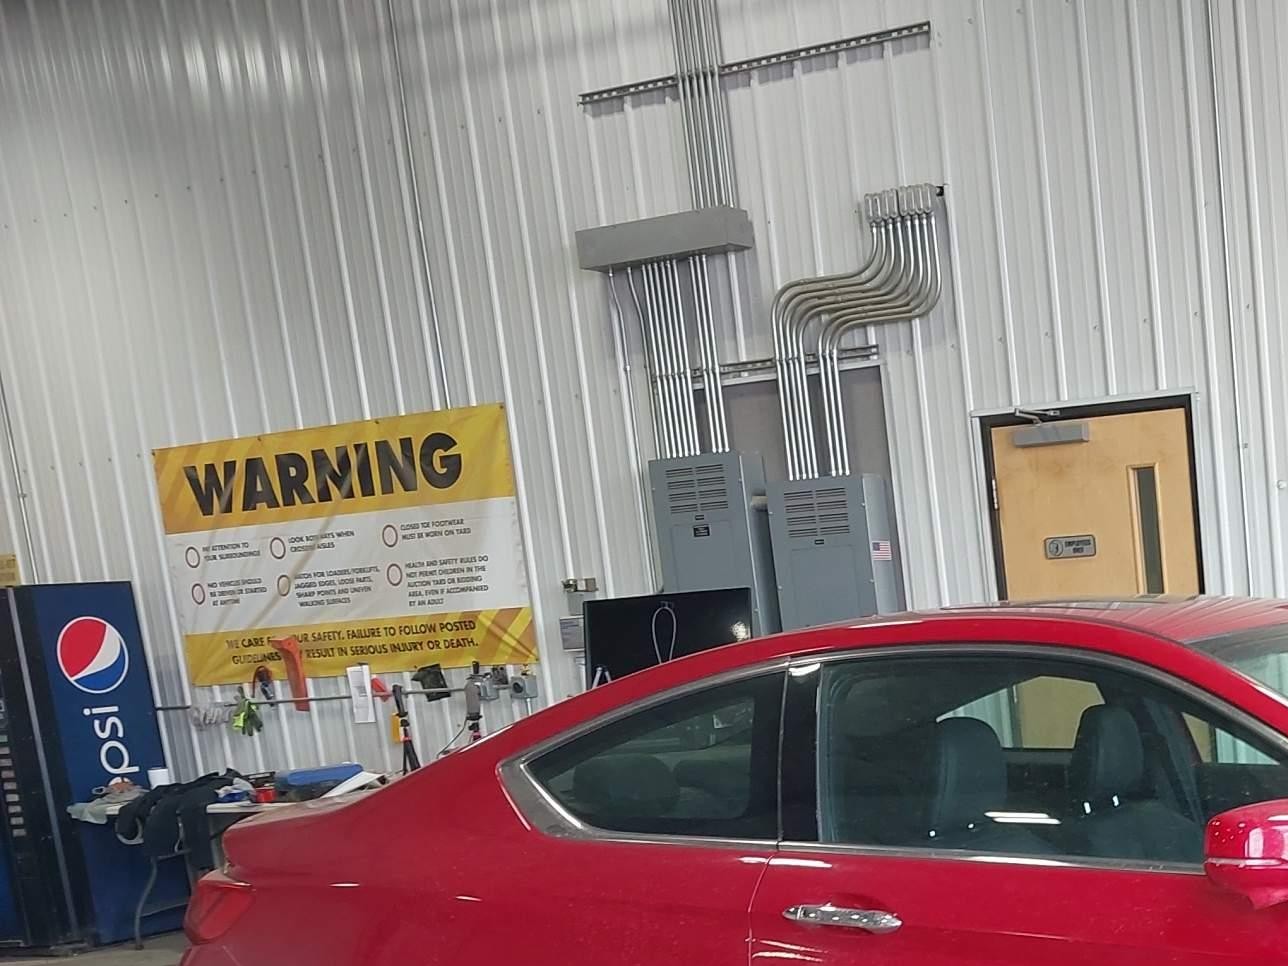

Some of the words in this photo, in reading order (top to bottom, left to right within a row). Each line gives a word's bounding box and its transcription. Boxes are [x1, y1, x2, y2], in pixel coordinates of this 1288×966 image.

[184, 432, 463, 517] WARNING
[431, 519, 464, 528] FOOTWEAR
[241, 637, 265, 648] CARE
[311, 629, 345, 641] SAFETY.
[347, 626, 382, 640] FAILURE
[383, 625, 396, 637] TO
[399, 622, 437, 636] FOLLOW
[439, 620, 476, 633] POSTED
[231, 651, 282, 665] GUIDELINES
[304, 647, 335, 659] RESULT
[337, 646, 348, 657] IN
[350, 643, 388, 656] SERIOUS
[390, 640, 424, 653] INJURY
[426, 639, 441, 650] OR
[443, 637, 479, 650] DEATH.
[83, 705, 140, 784] psi
